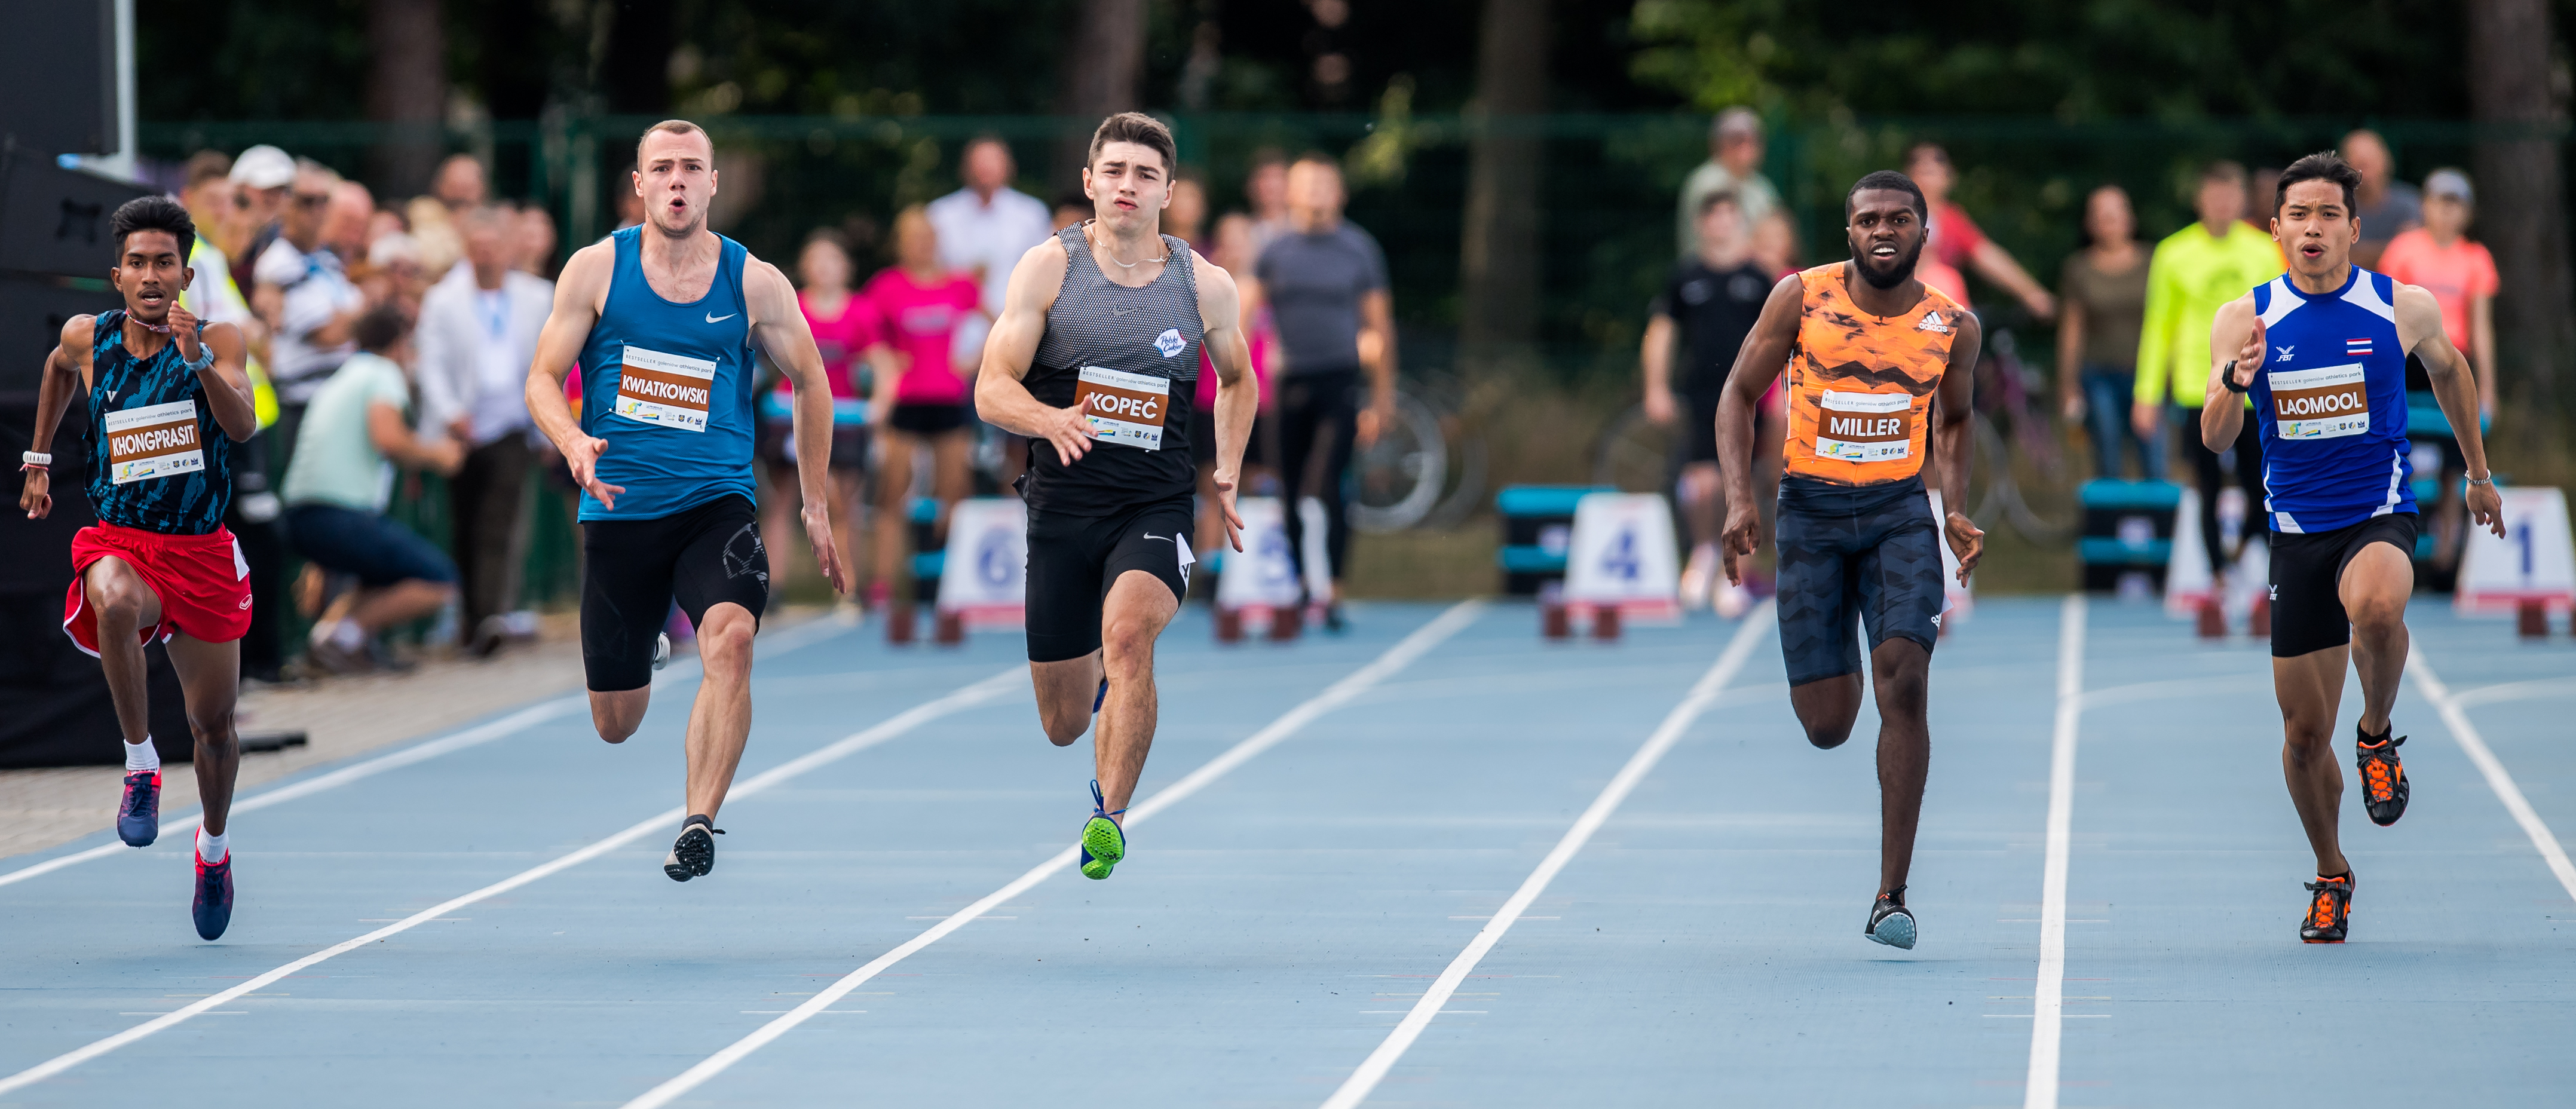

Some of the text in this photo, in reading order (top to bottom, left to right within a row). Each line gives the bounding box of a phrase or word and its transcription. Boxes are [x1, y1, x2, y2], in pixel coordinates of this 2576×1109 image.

[1919, 323, 1948, 332] adidas
[1160, 335, 1178, 345] Polski
[1163, 343, 1183, 352] Cukier
[626, 354, 656, 364] BESTSELLER
[679, 363, 700, 372] athletics
[1083, 370, 1114, 379] BESTSELLER
[622, 374, 707, 405] KWIATKOWSKI
[1090, 391, 1158, 419] KOPEĆ
[2278, 391, 2363, 415] LAOMOOL
[108, 418, 134, 426] BESTSELLER
[1830, 416, 1901, 436] MILLER
[112, 424, 195, 457] KHONGPRASIT
[1599, 522, 1641, 584] 4
[2507, 515, 2534, 578] 1
